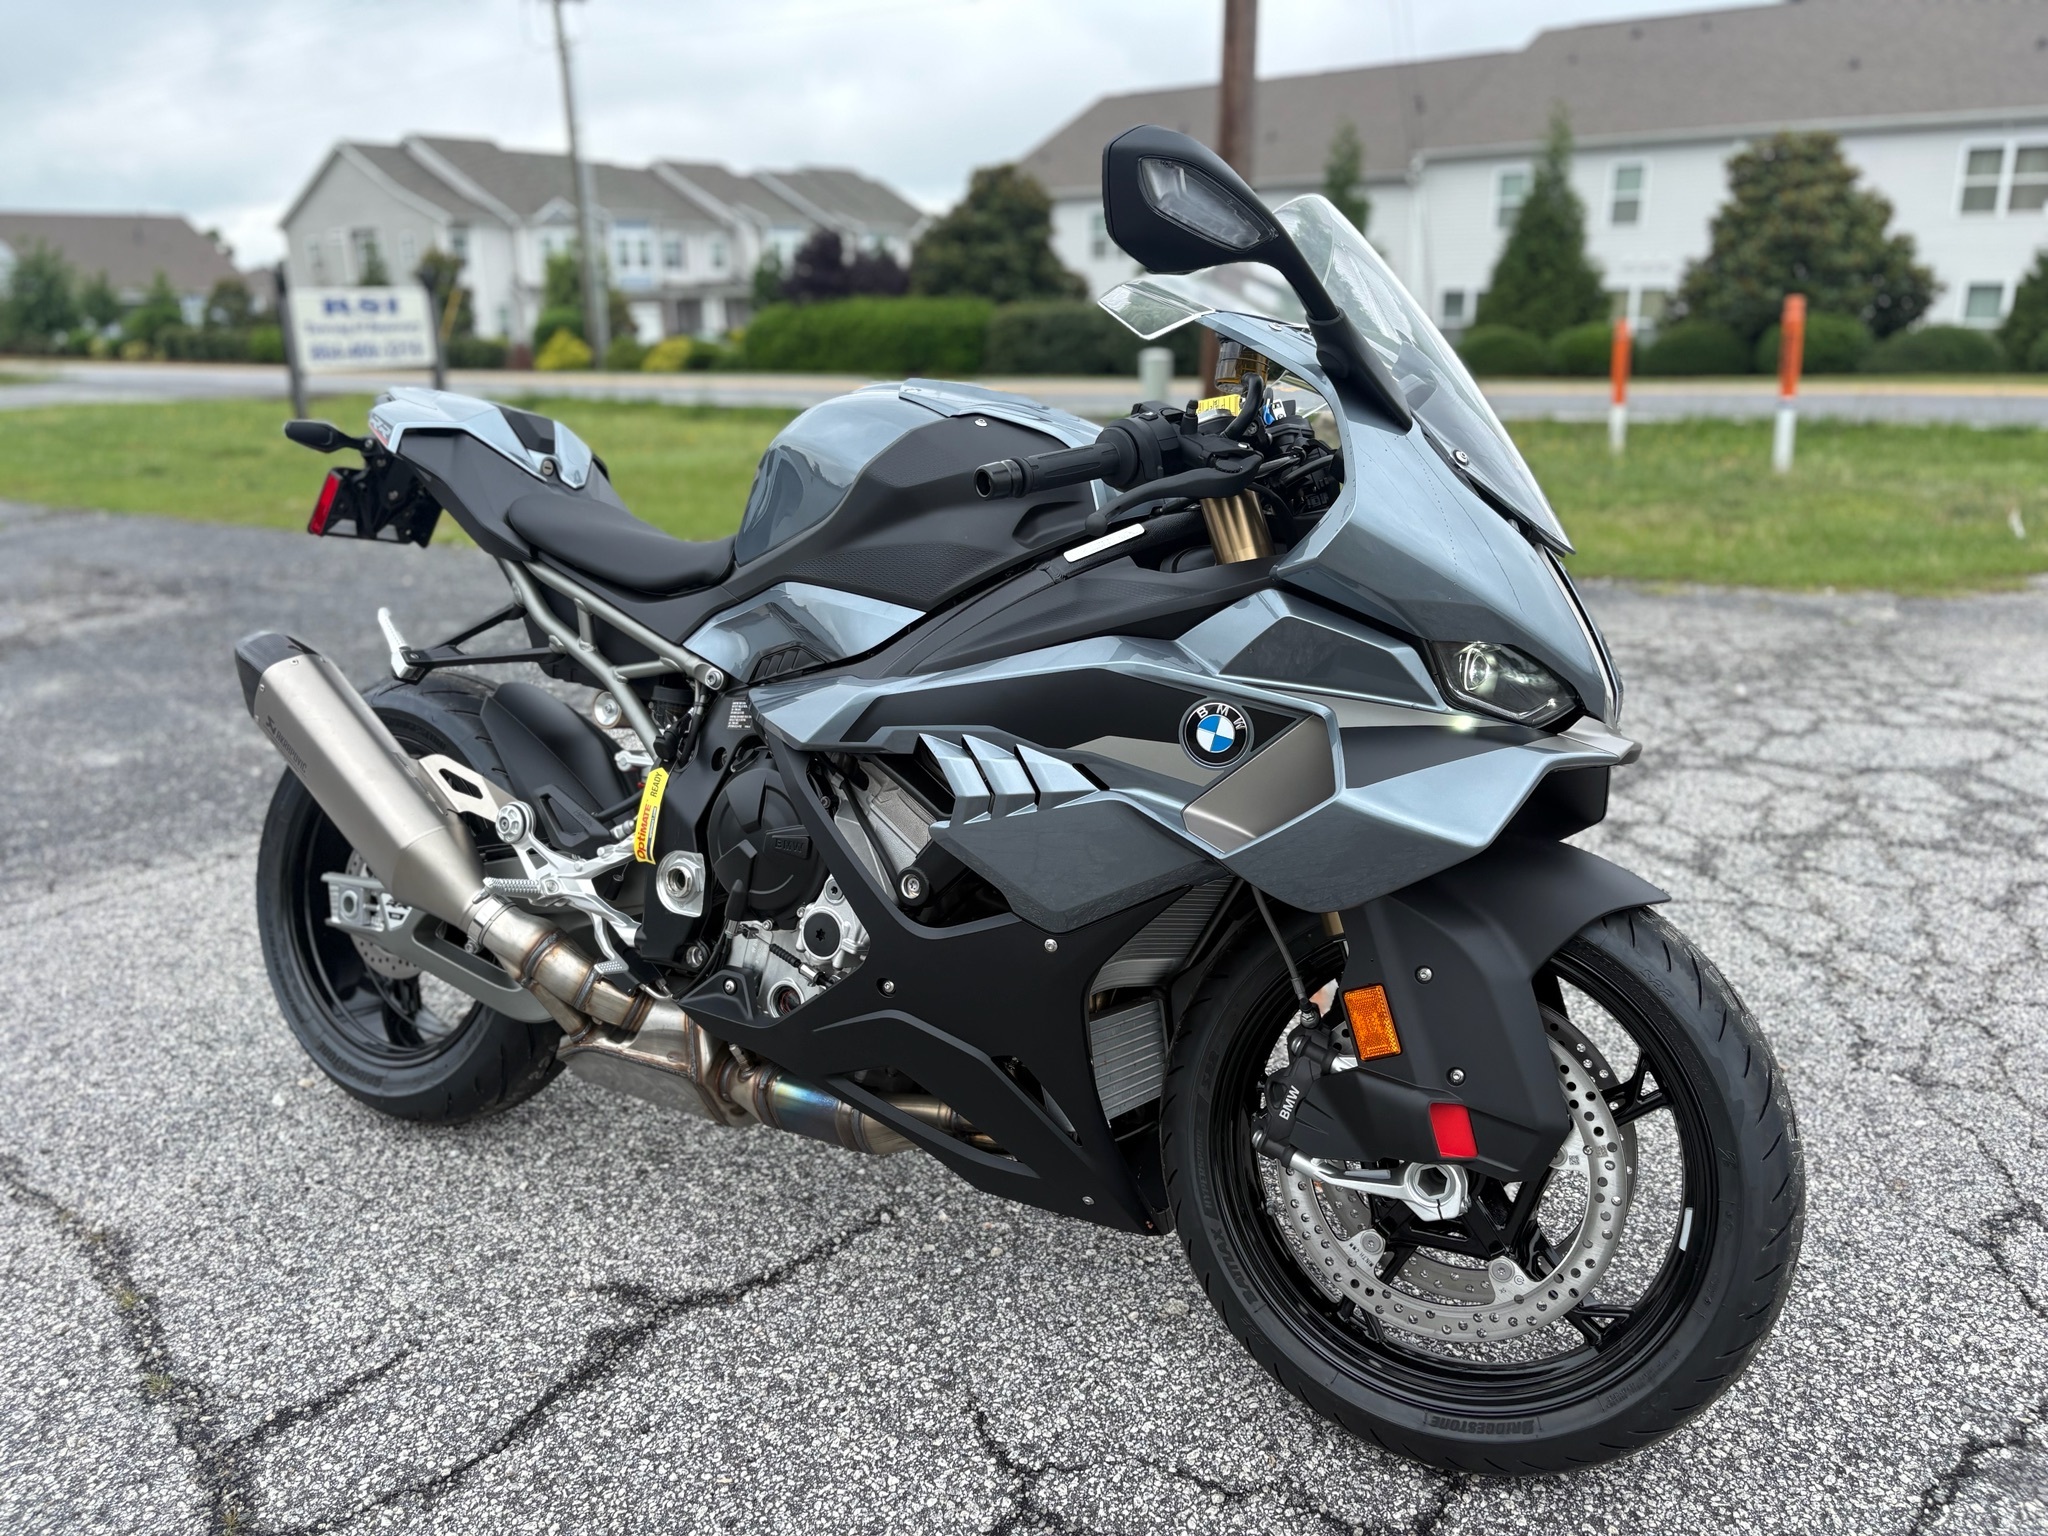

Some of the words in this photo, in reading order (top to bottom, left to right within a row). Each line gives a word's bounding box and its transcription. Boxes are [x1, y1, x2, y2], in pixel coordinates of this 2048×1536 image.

[1196, 703, 1246, 731] BMW
[636, 803, 652, 860] OptiMATE
[649, 771, 663, 798] READY
[775, 838, 804, 854] BMW
[1279, 1085, 1300, 1121] BMW
[1209, 1226, 1258, 1303] BATTLAX
[1431, 1414, 1534, 1436] BRIDGESTONE
